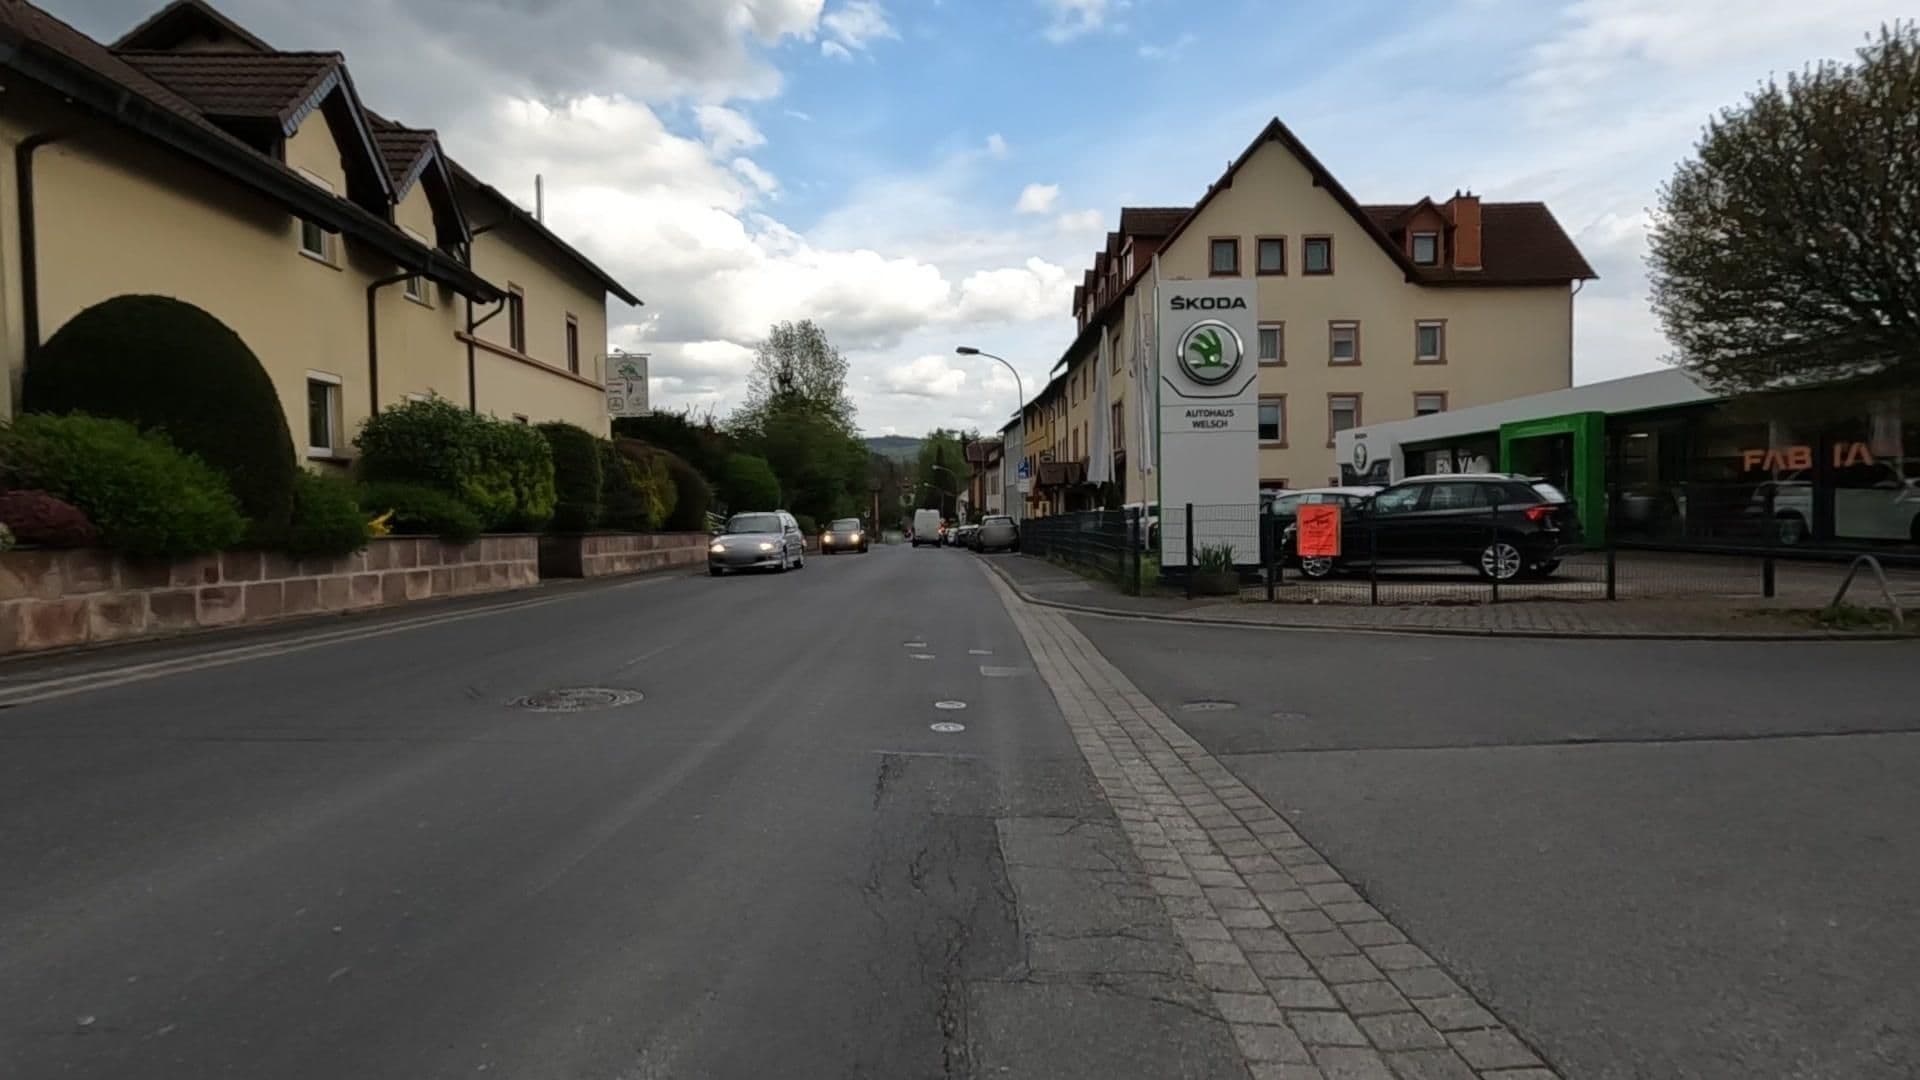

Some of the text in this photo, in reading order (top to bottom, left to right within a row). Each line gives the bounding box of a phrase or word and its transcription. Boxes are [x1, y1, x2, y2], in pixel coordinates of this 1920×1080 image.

[1170, 296, 1246, 310] ŠKODA
[1185, 409, 1235, 418] AUTOHAUS
[1192, 420, 1228, 429] WELSCH
